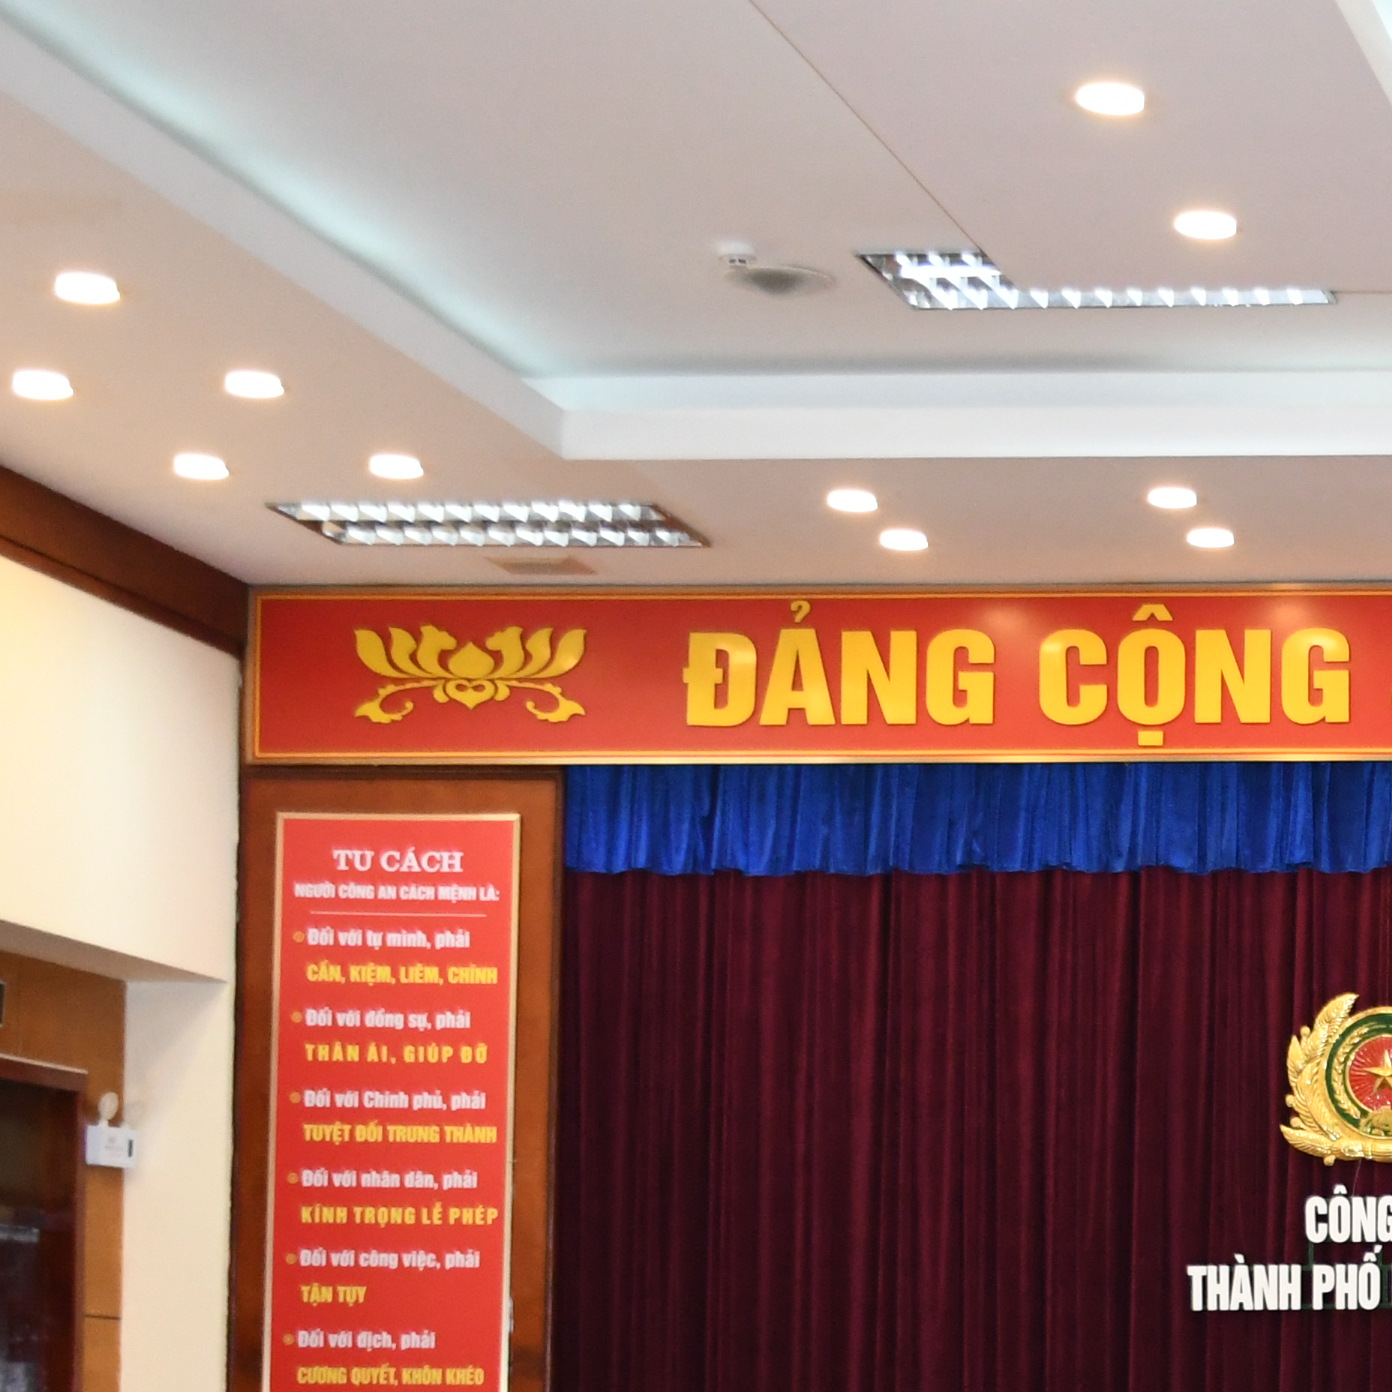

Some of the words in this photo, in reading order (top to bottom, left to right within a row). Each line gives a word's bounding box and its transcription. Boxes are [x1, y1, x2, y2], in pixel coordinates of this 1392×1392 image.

[682, 599, 998, 729] ĐẢNG
[1040, 604, 1352, 748] CỘNG
[380, 847, 463, 873] CÁCH
[1187, 1253, 1300, 1311] THÀNH
[1312, 1245, 1382, 1310] PHỐ
